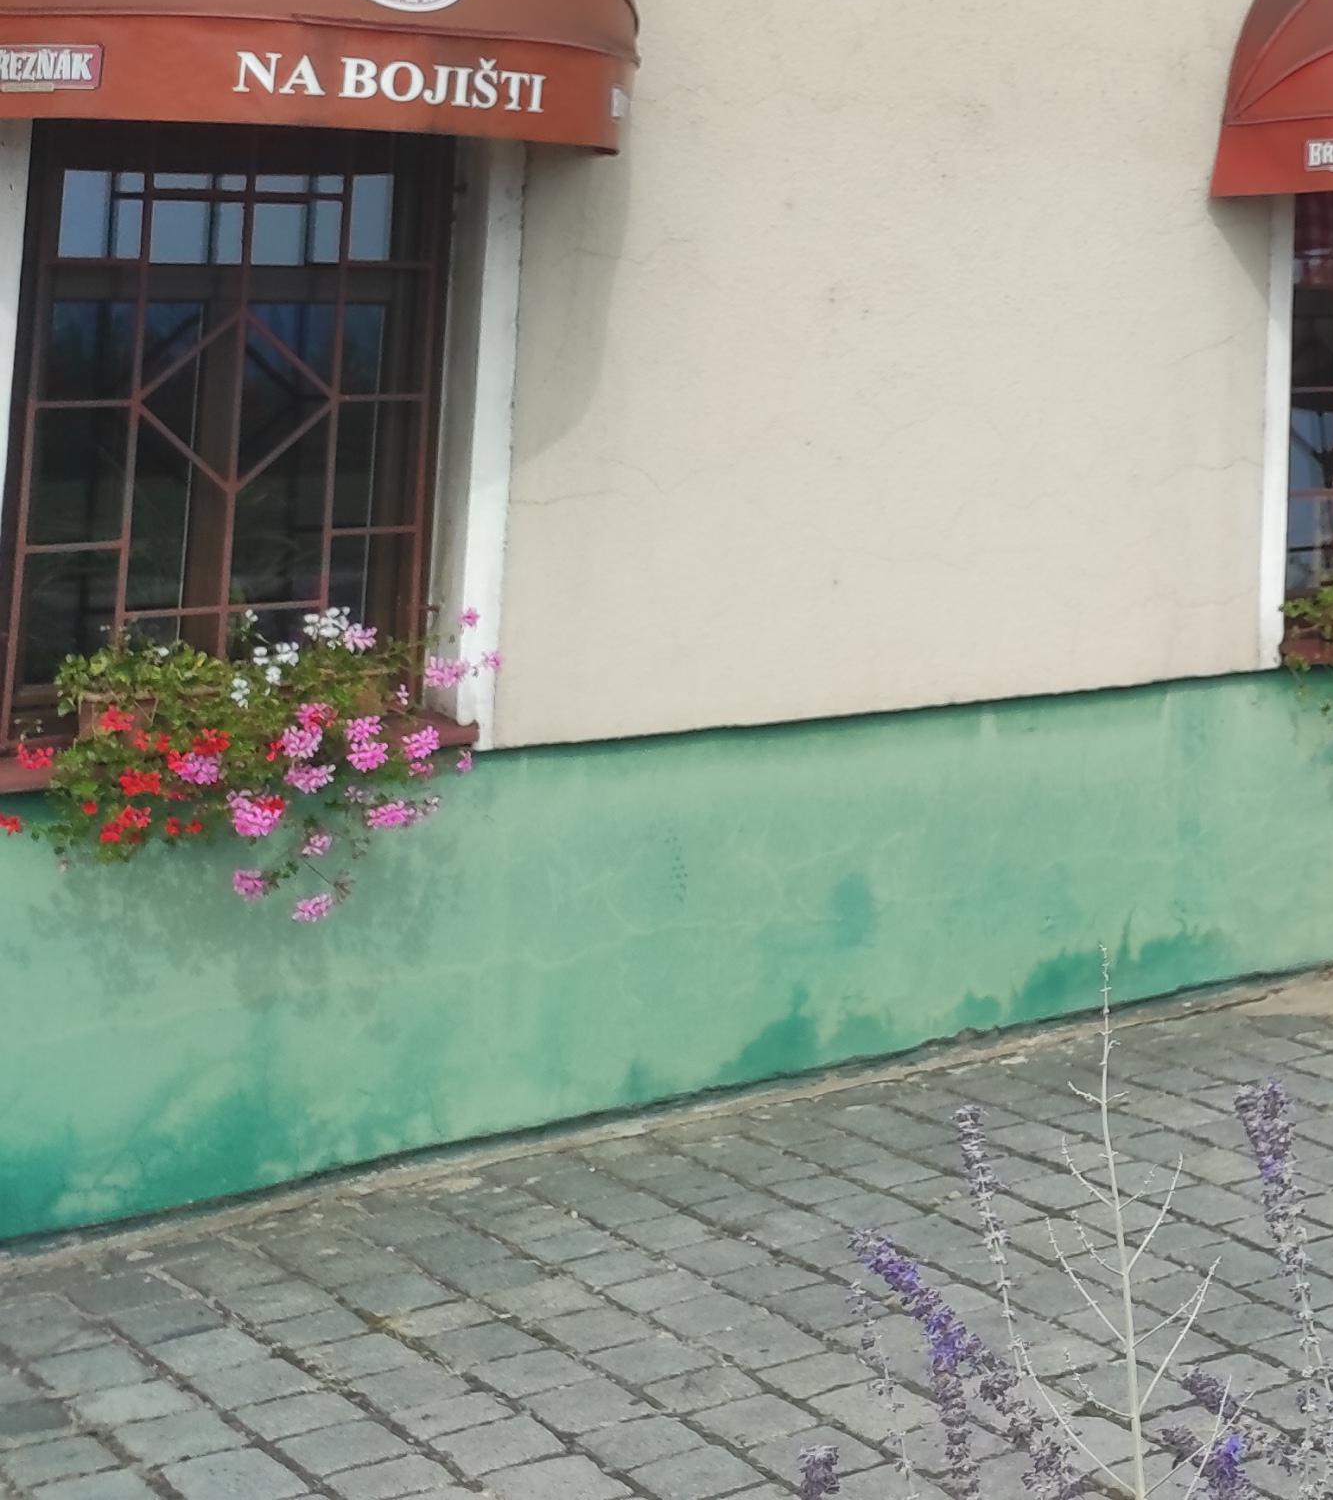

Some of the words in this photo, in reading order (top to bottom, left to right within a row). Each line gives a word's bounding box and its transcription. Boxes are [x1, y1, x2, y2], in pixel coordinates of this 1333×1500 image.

[0, 49, 94, 82] ŘEZŇÁK
[233, 51, 326, 98] NA
[338, 57, 548, 114] BOJIŠTI
